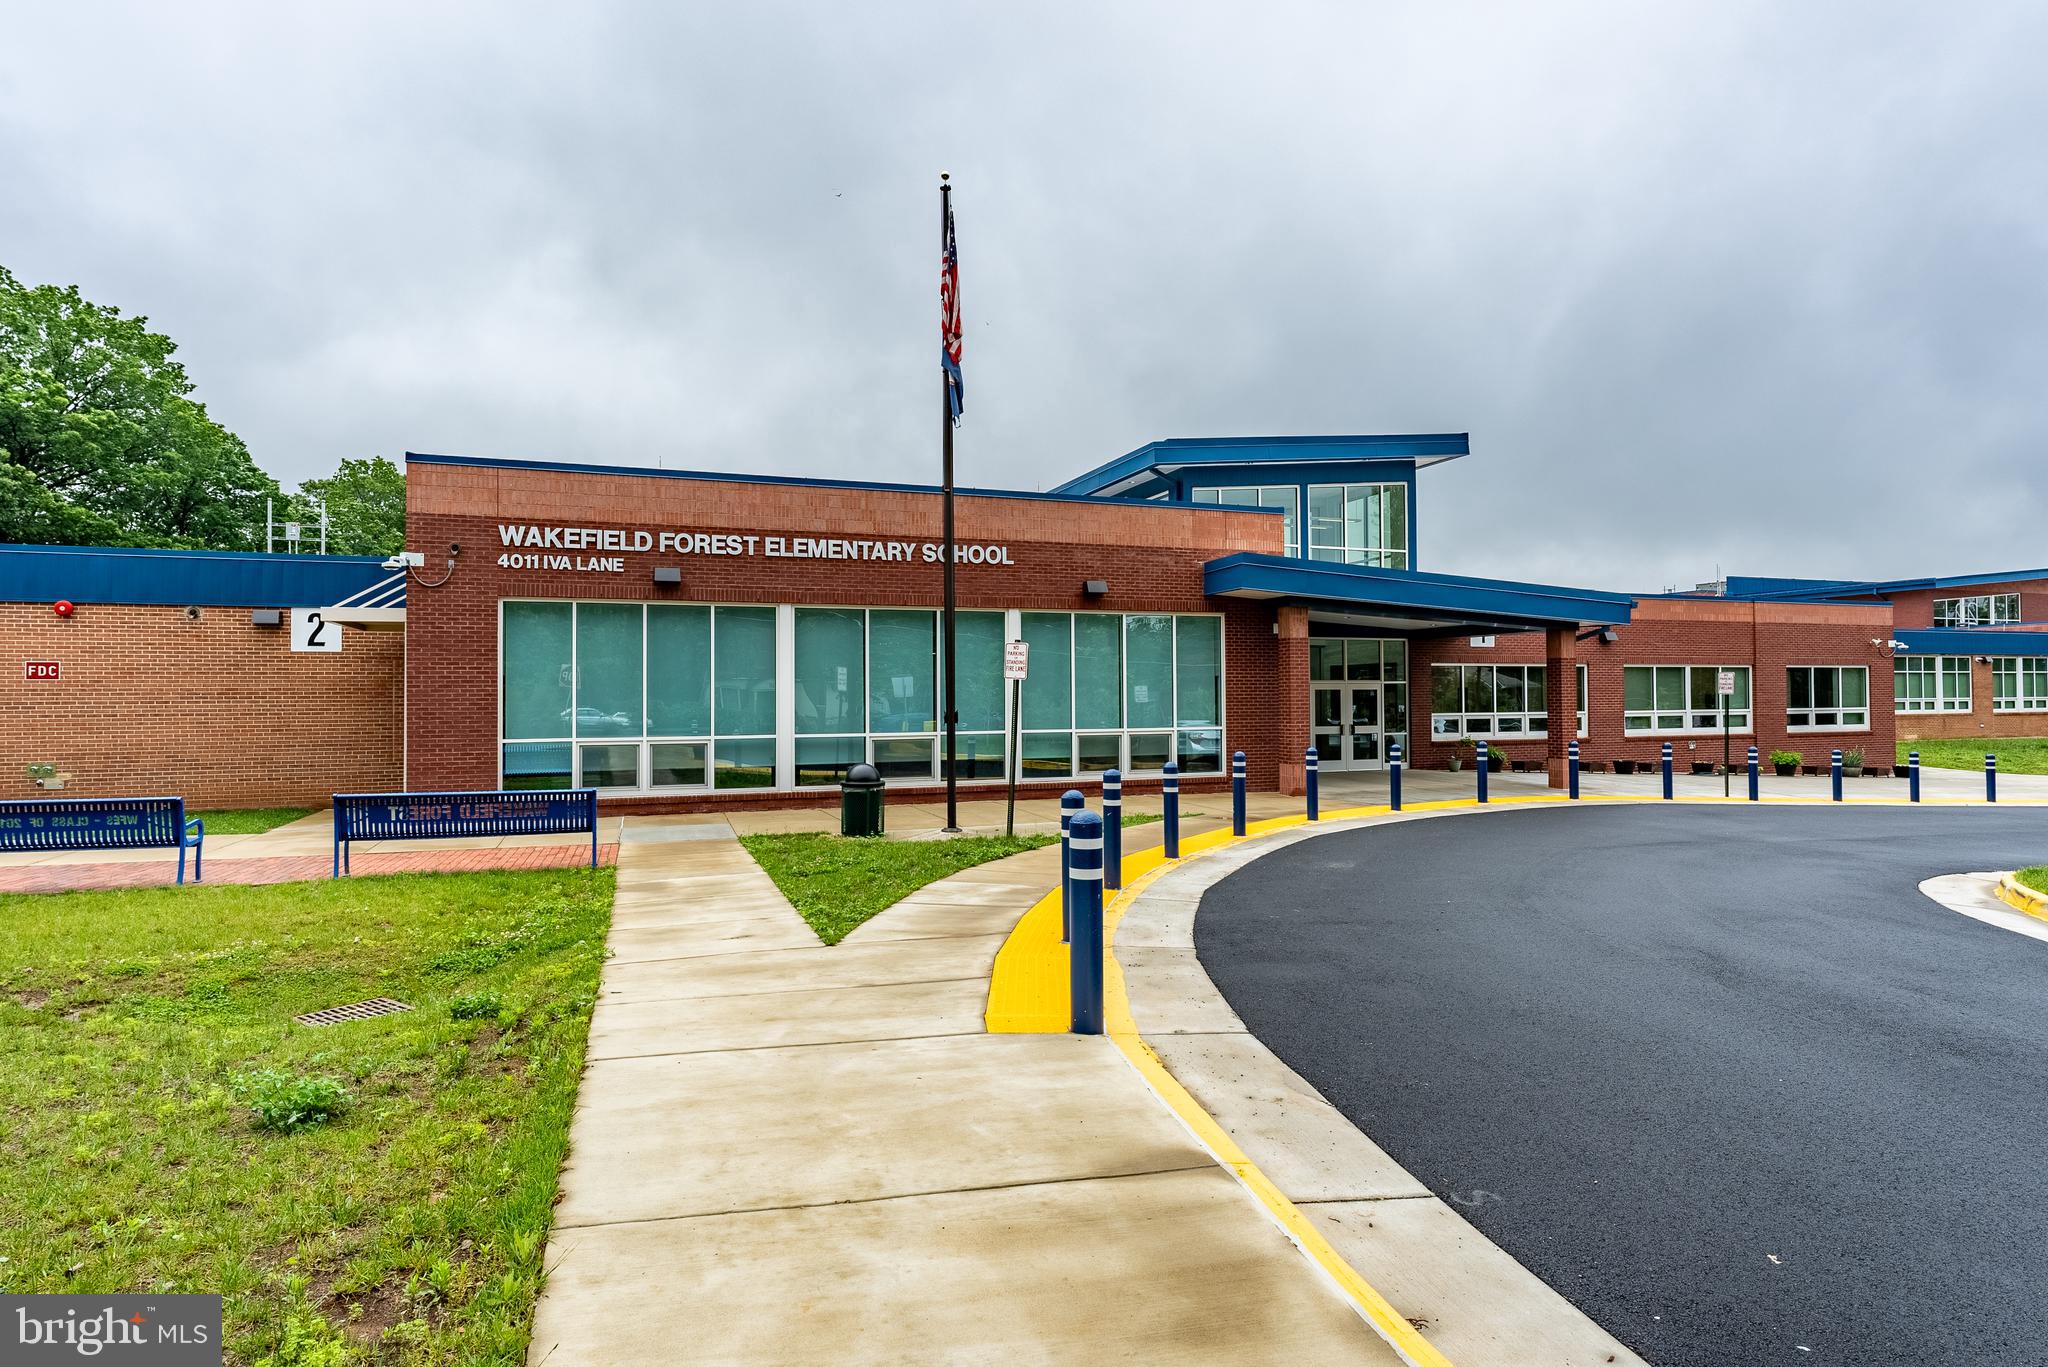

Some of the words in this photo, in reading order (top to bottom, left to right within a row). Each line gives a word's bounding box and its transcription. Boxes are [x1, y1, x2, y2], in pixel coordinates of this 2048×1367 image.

[498, 525, 653, 552] WAKEFIELD
[659, 532, 760, 556] FOREST
[764, 536, 916, 562] ELEMENTARY
[497, 553, 539, 569] 4011
[543, 555, 572, 571] IVA
[576, 556, 625, 572] LANE
[307, 612, 326, 647] 2
[28, 665, 57, 676] FDC
